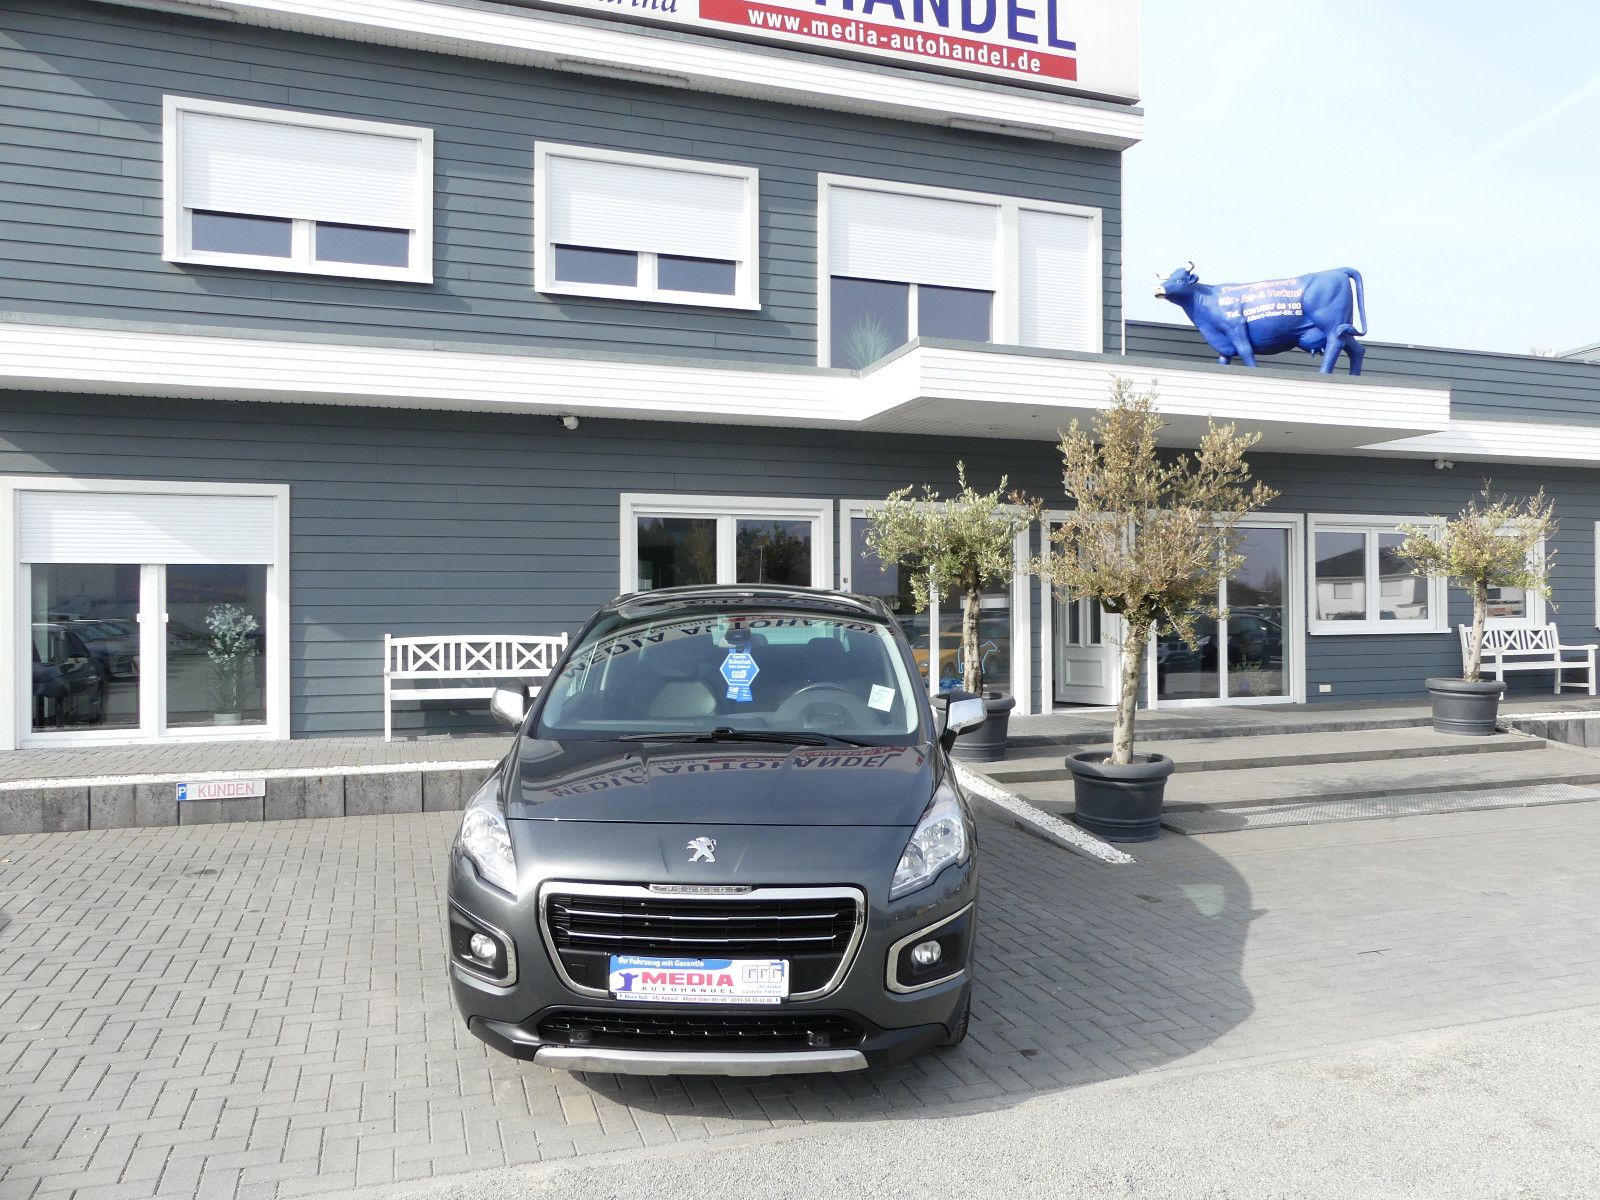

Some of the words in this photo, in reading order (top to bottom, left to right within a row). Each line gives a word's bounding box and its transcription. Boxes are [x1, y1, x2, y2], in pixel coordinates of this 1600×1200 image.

[815, 0, 1077, 51] NDEL
[748, 8, 1041, 72] www.media-autohandel.de
[1287, 302, 1302, 310] 100
[197, 781, 254, 798] KUNDEN
[629, 957, 660, 967] Fahrzeug
[661, 959, 674, 967] mit
[674, 959, 705, 967] Garantie
[641, 971, 734, 987] MEDIA
[641, 986, 735, 994] AUTOHANDEL
